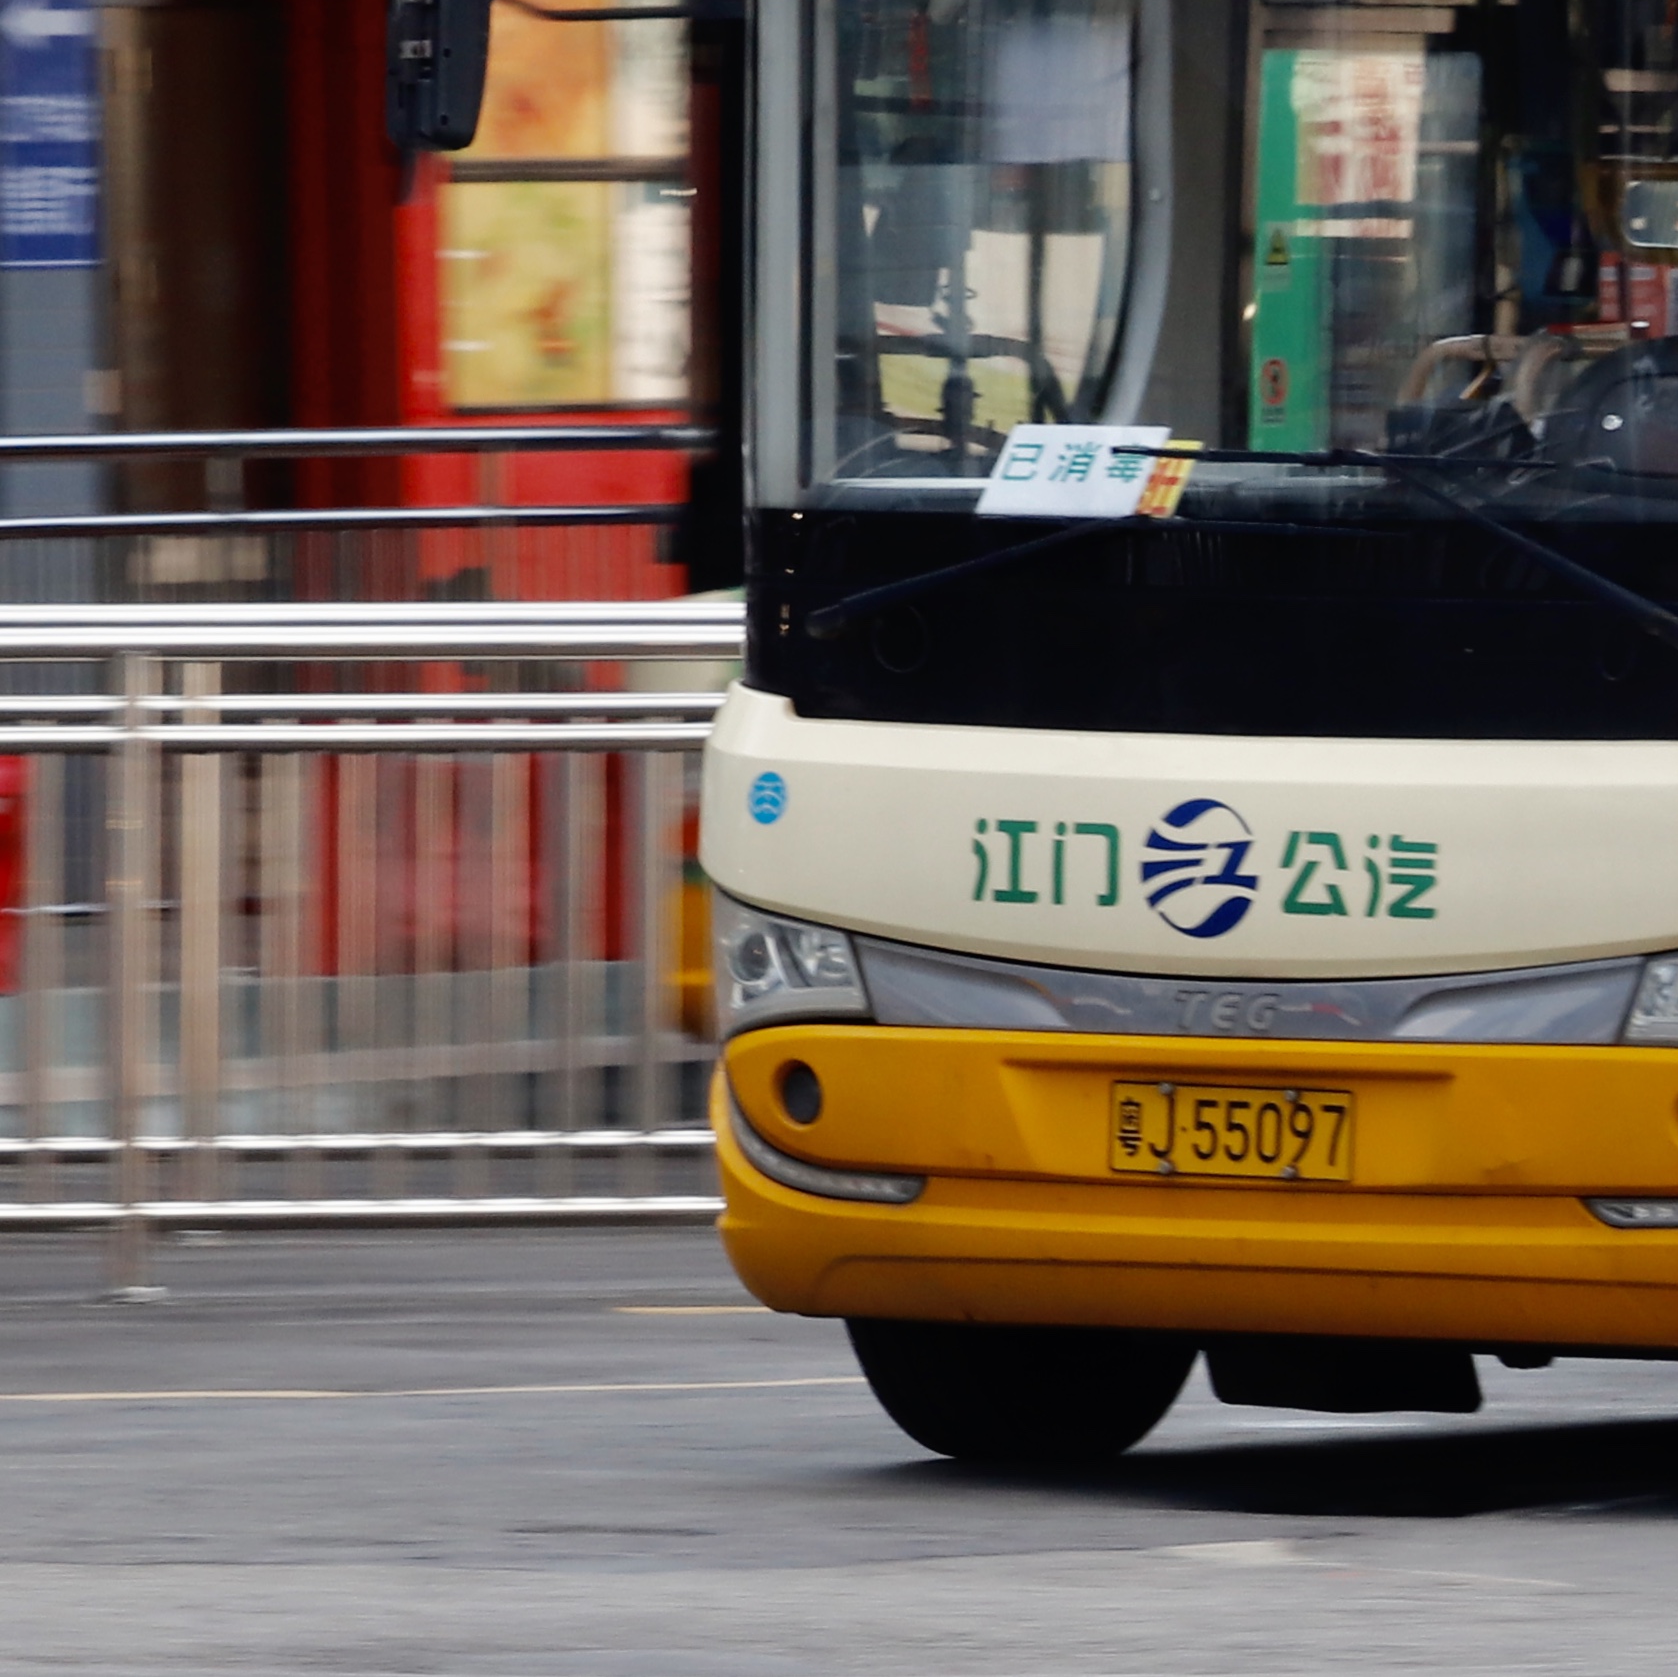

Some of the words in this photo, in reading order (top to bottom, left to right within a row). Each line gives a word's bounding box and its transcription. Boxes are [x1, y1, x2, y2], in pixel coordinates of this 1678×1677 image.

[973, 818, 1121, 907] 江门
[1280, 831, 1439, 919] 公汽
[1174, 989, 1283, 1033] TEG
